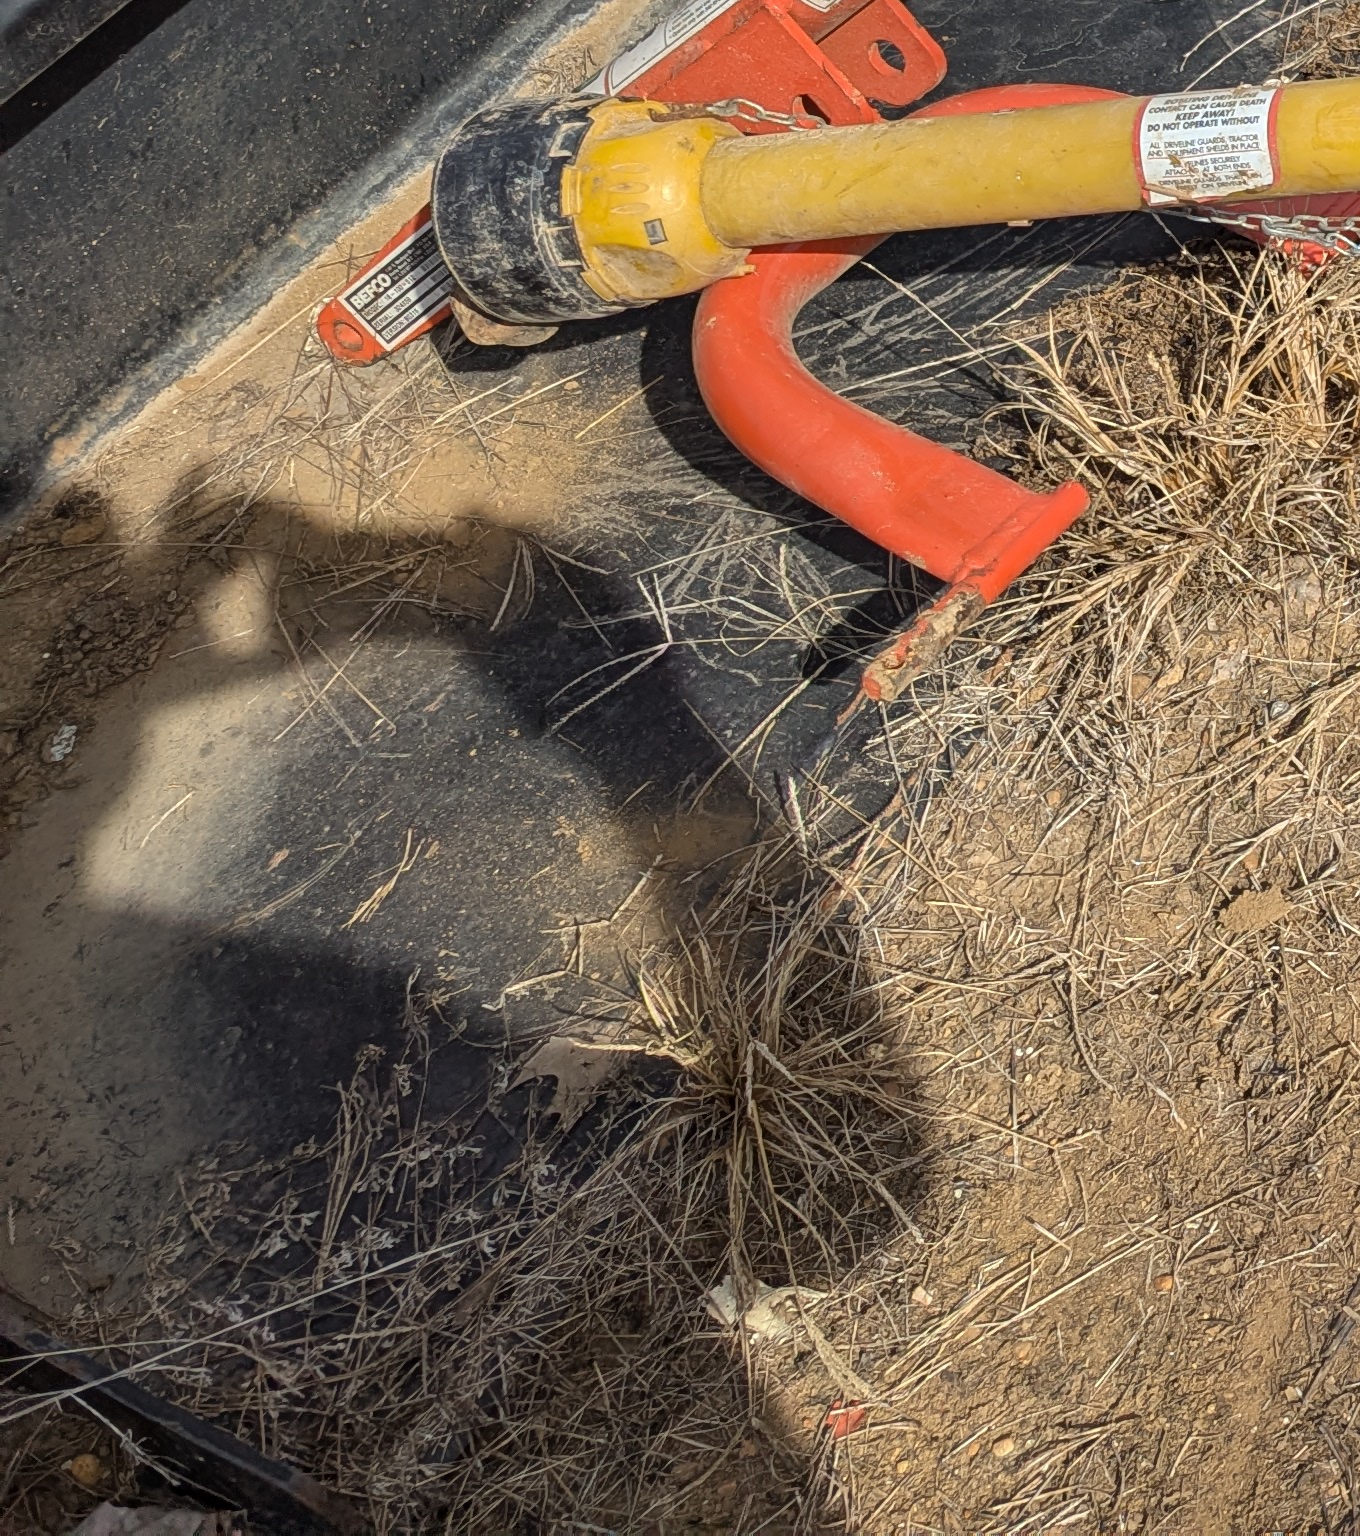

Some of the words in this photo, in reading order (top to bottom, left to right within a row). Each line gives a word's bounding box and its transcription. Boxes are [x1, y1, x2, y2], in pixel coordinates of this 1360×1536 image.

[1149, 104, 1187, 114] CONTACT
[1189, 102, 1209, 110] CAN
[1210, 100, 1238, 109] CAUSE
[1239, 98, 1267, 107] DEATH
[1175, 111, 1200, 121] KEEP
[1201, 109, 1235, 119] AWAY!
[1147, 123, 1161, 132] DO
[1162, 121, 1181, 131] NOT
[1183, 119, 1219, 130] OPERATE
[1221, 116, 1260, 127] WITHOUT
[1147, 149, 1163, 157] AND
[1231, 143, 1239, 151] IN
[1240, 142, 1260, 150] PLACE
[1163, 139, 1195, 149] DRIVELINE
[1164, 167, 1199, 176] ATTACHD
[1213, 163, 1232, 172] BOTH
[350, 273, 391, 310] BEFCO
